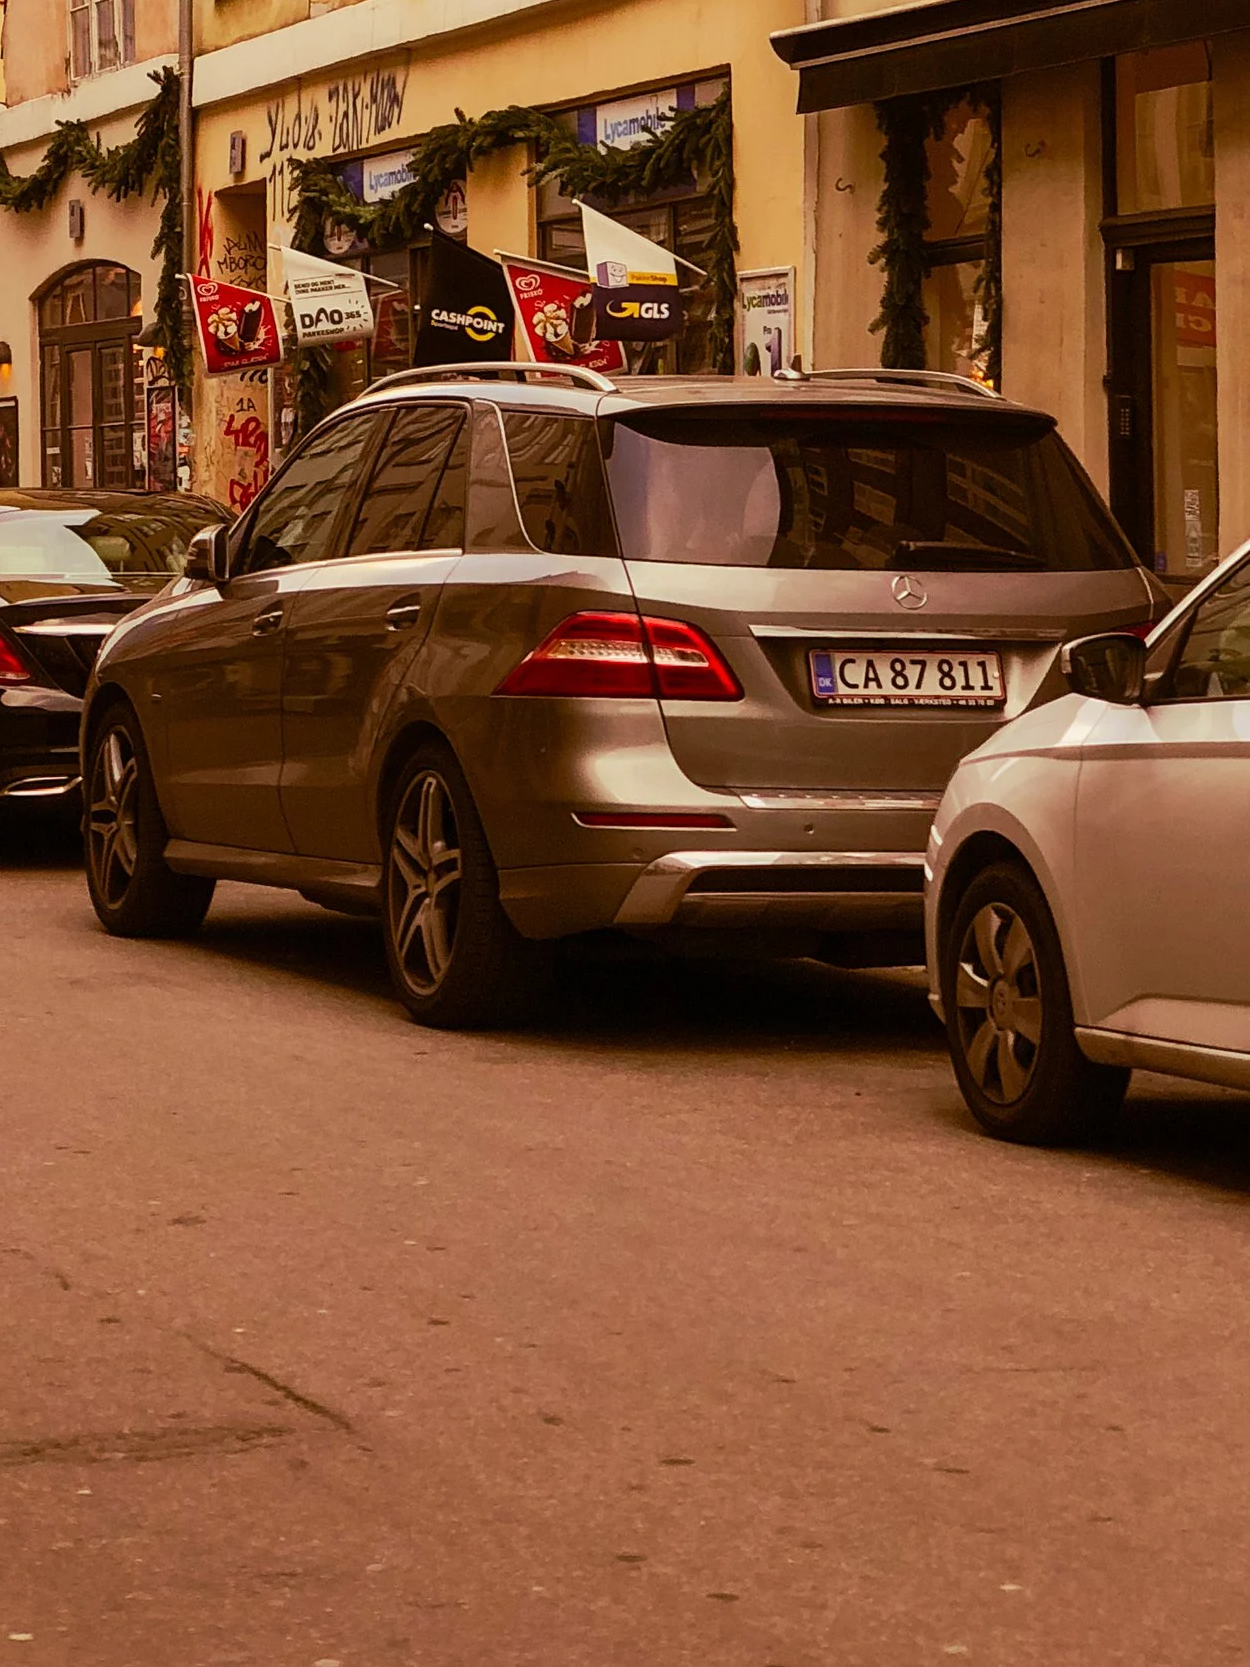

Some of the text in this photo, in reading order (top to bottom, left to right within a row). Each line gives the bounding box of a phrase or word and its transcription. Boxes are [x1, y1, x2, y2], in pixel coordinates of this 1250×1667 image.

[300, 307, 362, 330] DAO 365
[431, 308, 505, 334] CASHPOINT
[640, 302, 670, 320] GLS
[818, 657, 994, 691] DK CA 87 811
